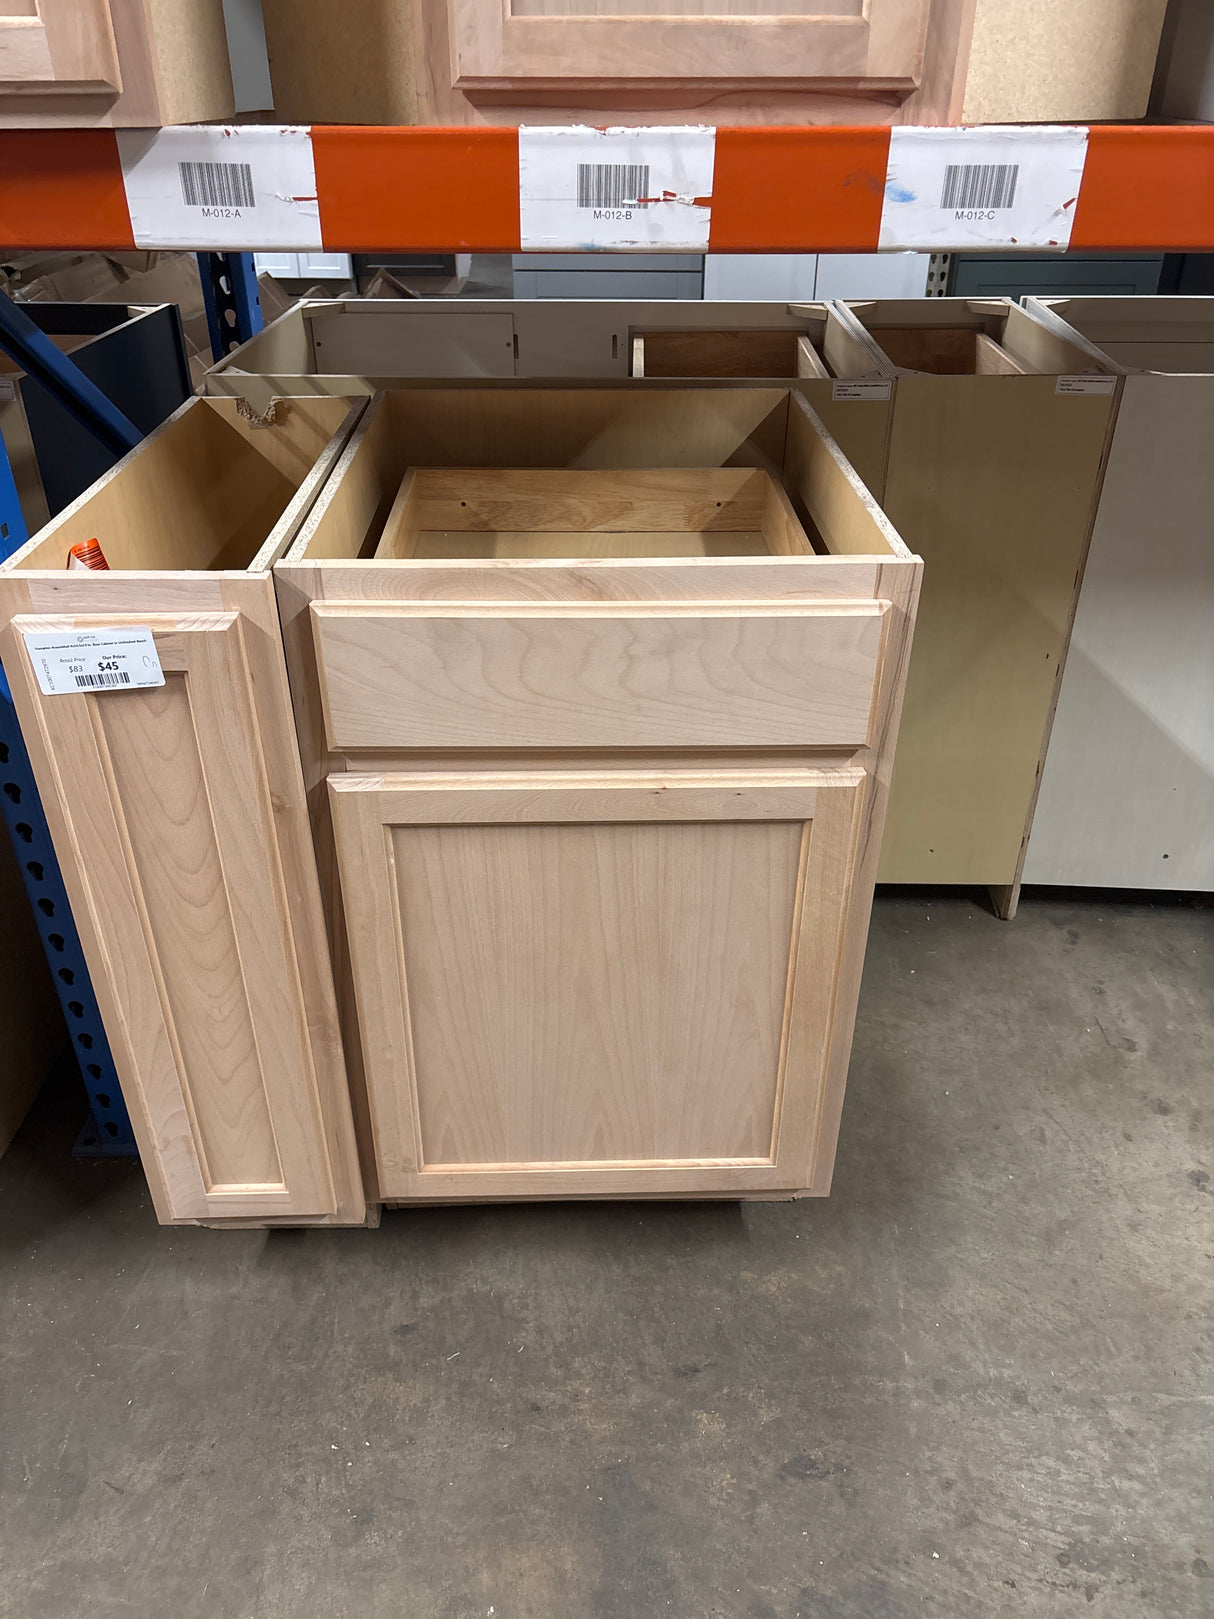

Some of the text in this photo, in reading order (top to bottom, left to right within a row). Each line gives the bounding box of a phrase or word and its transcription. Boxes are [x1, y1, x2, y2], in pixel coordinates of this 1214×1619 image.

[202, 208, 241, 218] M-012-A
[593, 210, 633, 220] M-012-B
[955, 210, 995, 220] M-012-C
[68, 665, 83, 673] $83
[98, 661, 119, 672] $45
